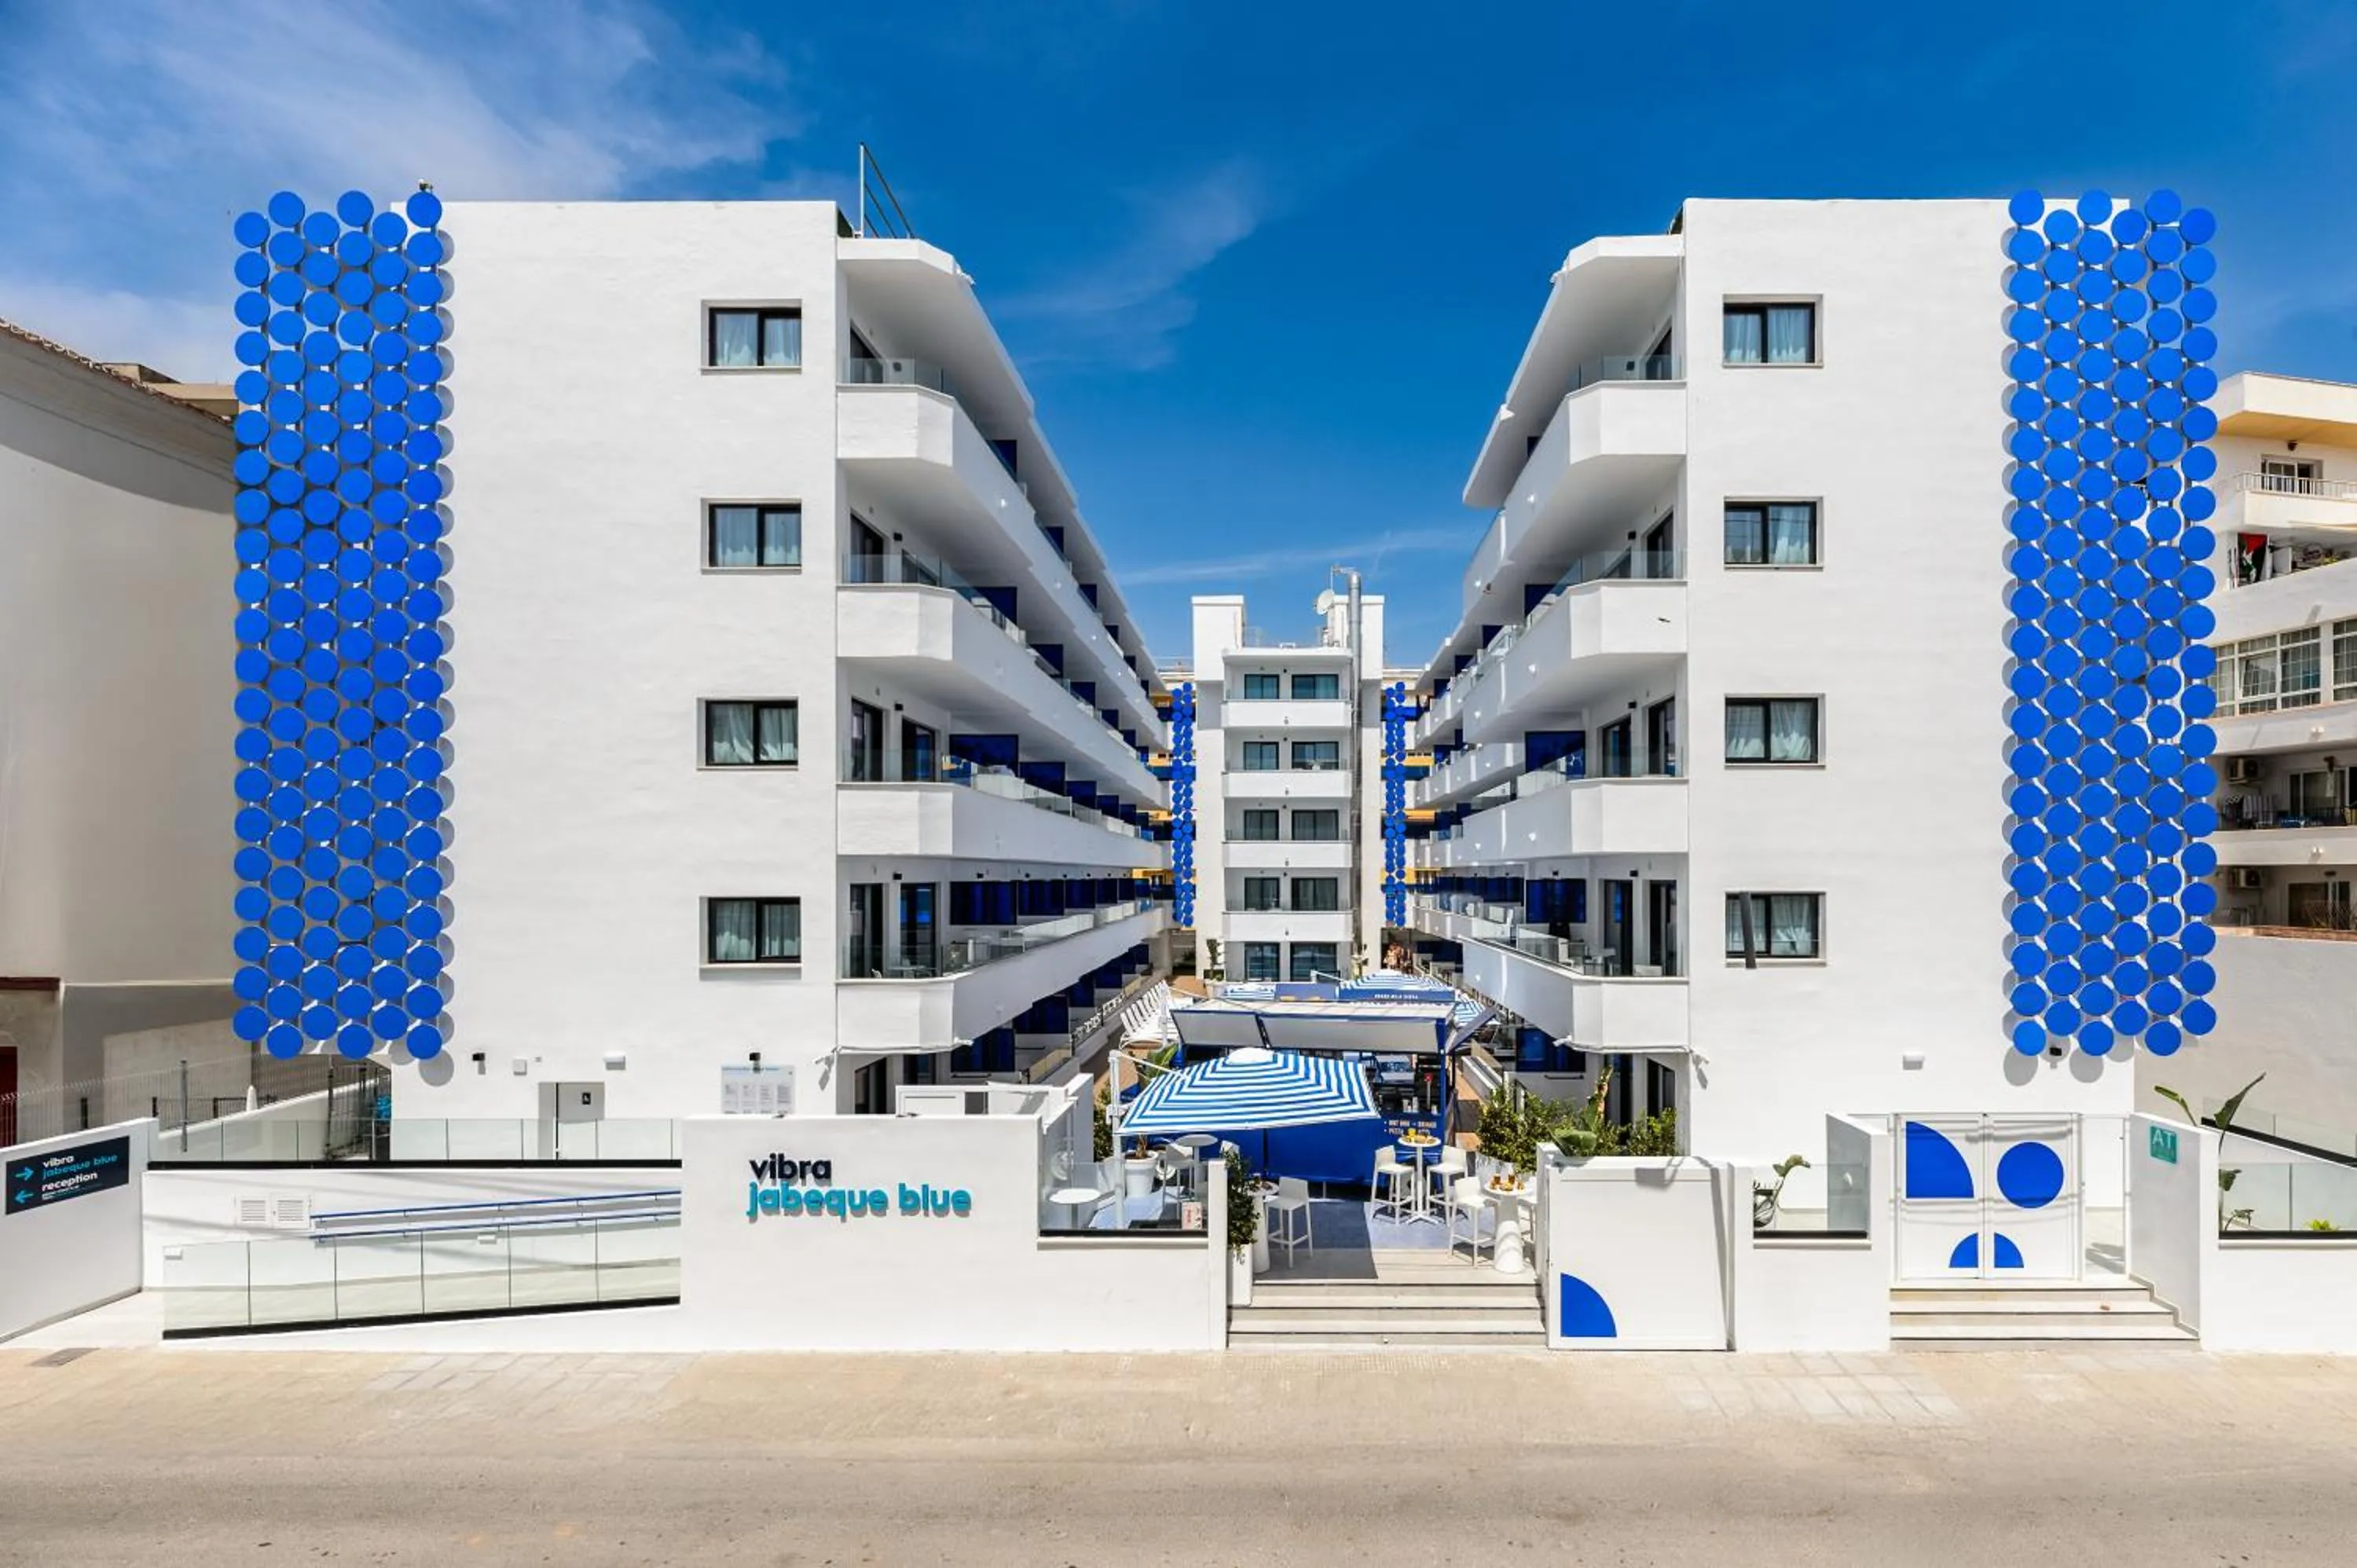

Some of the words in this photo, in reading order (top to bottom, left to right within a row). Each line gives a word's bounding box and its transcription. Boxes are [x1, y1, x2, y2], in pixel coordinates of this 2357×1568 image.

[2153, 1129, 2176, 1149] AT
[42, 1156, 75, 1168] vibra
[42, 1161, 90, 1180] jabeque
[93, 1154, 118, 1167] blue
[749, 1152, 832, 1180] vibra
[42, 1171, 98, 1192] reception
[747, 1181, 889, 1218] jabeque
[898, 1182, 972, 1211] blue
